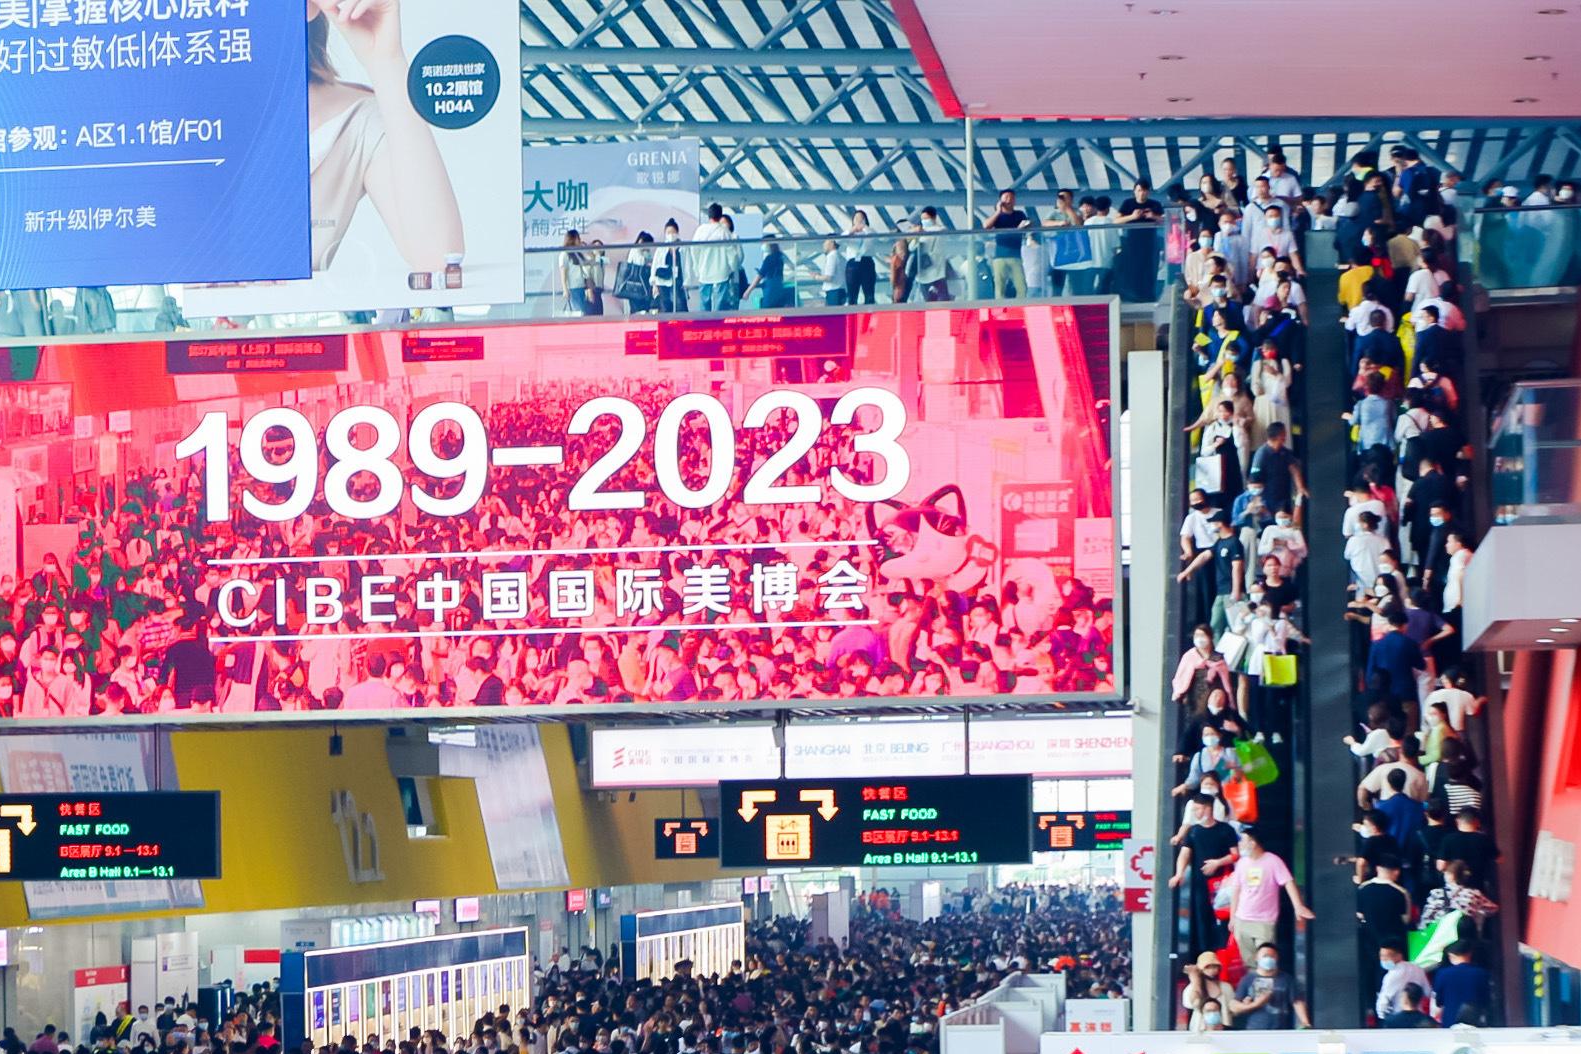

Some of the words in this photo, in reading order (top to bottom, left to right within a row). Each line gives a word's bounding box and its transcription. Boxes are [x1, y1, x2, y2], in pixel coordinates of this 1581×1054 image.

[425, 80, 484, 97] 10.2展馆
[434, 99, 475, 115] H04A
[627, 151, 688, 167] GRENIA
[523, 179, 589, 214] 大咖
[24, 205, 157, 234] 新升级|伊尔美
[524, 216, 590, 238] 酶活性
[174, 388, 912, 525] 1989-2023
[863, 808, 896, 822] FAST
[900, 808, 938, 822] FOOD
[59, 824, 91, 837] FAST
[94, 824, 130, 836] FOOD
[863, 853, 892, 866] Area
[893, 853, 903, 866] B
[905, 852, 929, 866] Hall
[60, 867, 87, 878] Area
[88, 867, 98, 878] B
[99, 866, 122, 878] Hall
